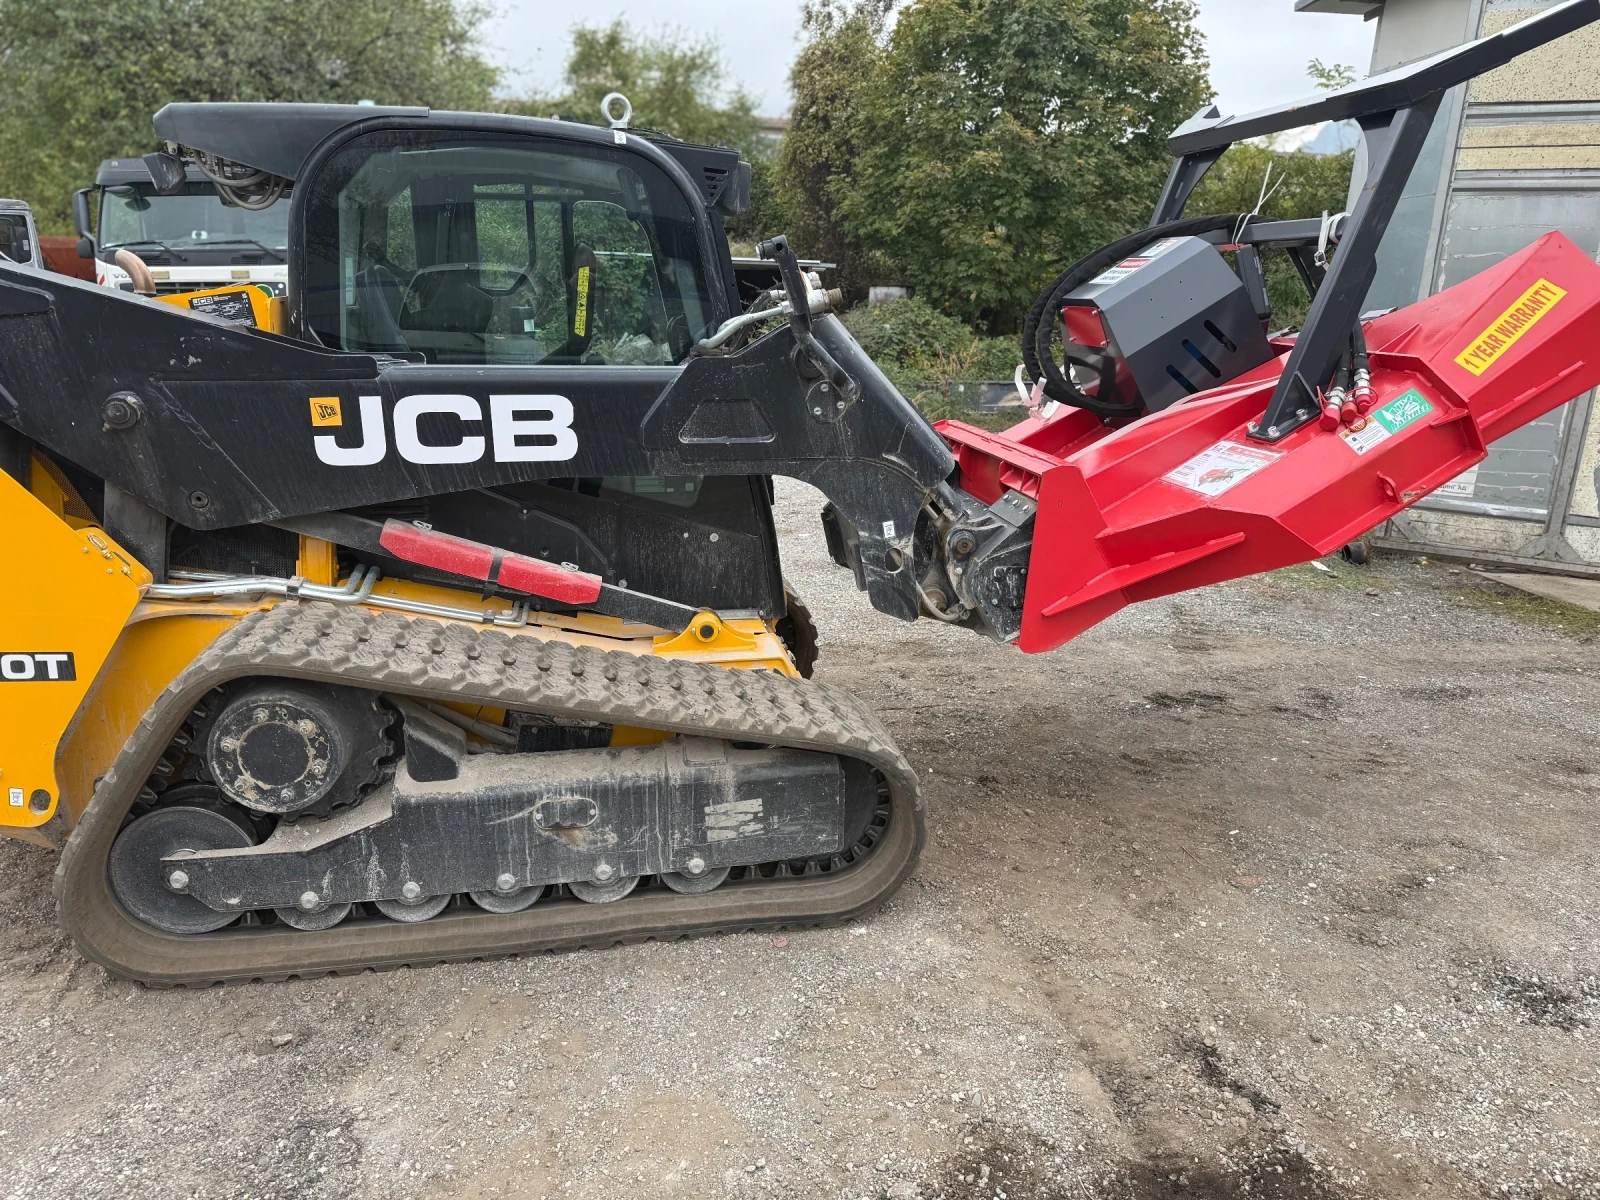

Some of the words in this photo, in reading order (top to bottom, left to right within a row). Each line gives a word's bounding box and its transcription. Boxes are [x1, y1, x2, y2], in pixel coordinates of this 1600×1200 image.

[1494, 284, 1557, 339] WARRANTY
[1463, 357, 1480, 369] 1
[1469, 333, 1507, 363] YEAR
[318, 405, 337, 419] JCB
[314, 394, 578, 466] JCB
